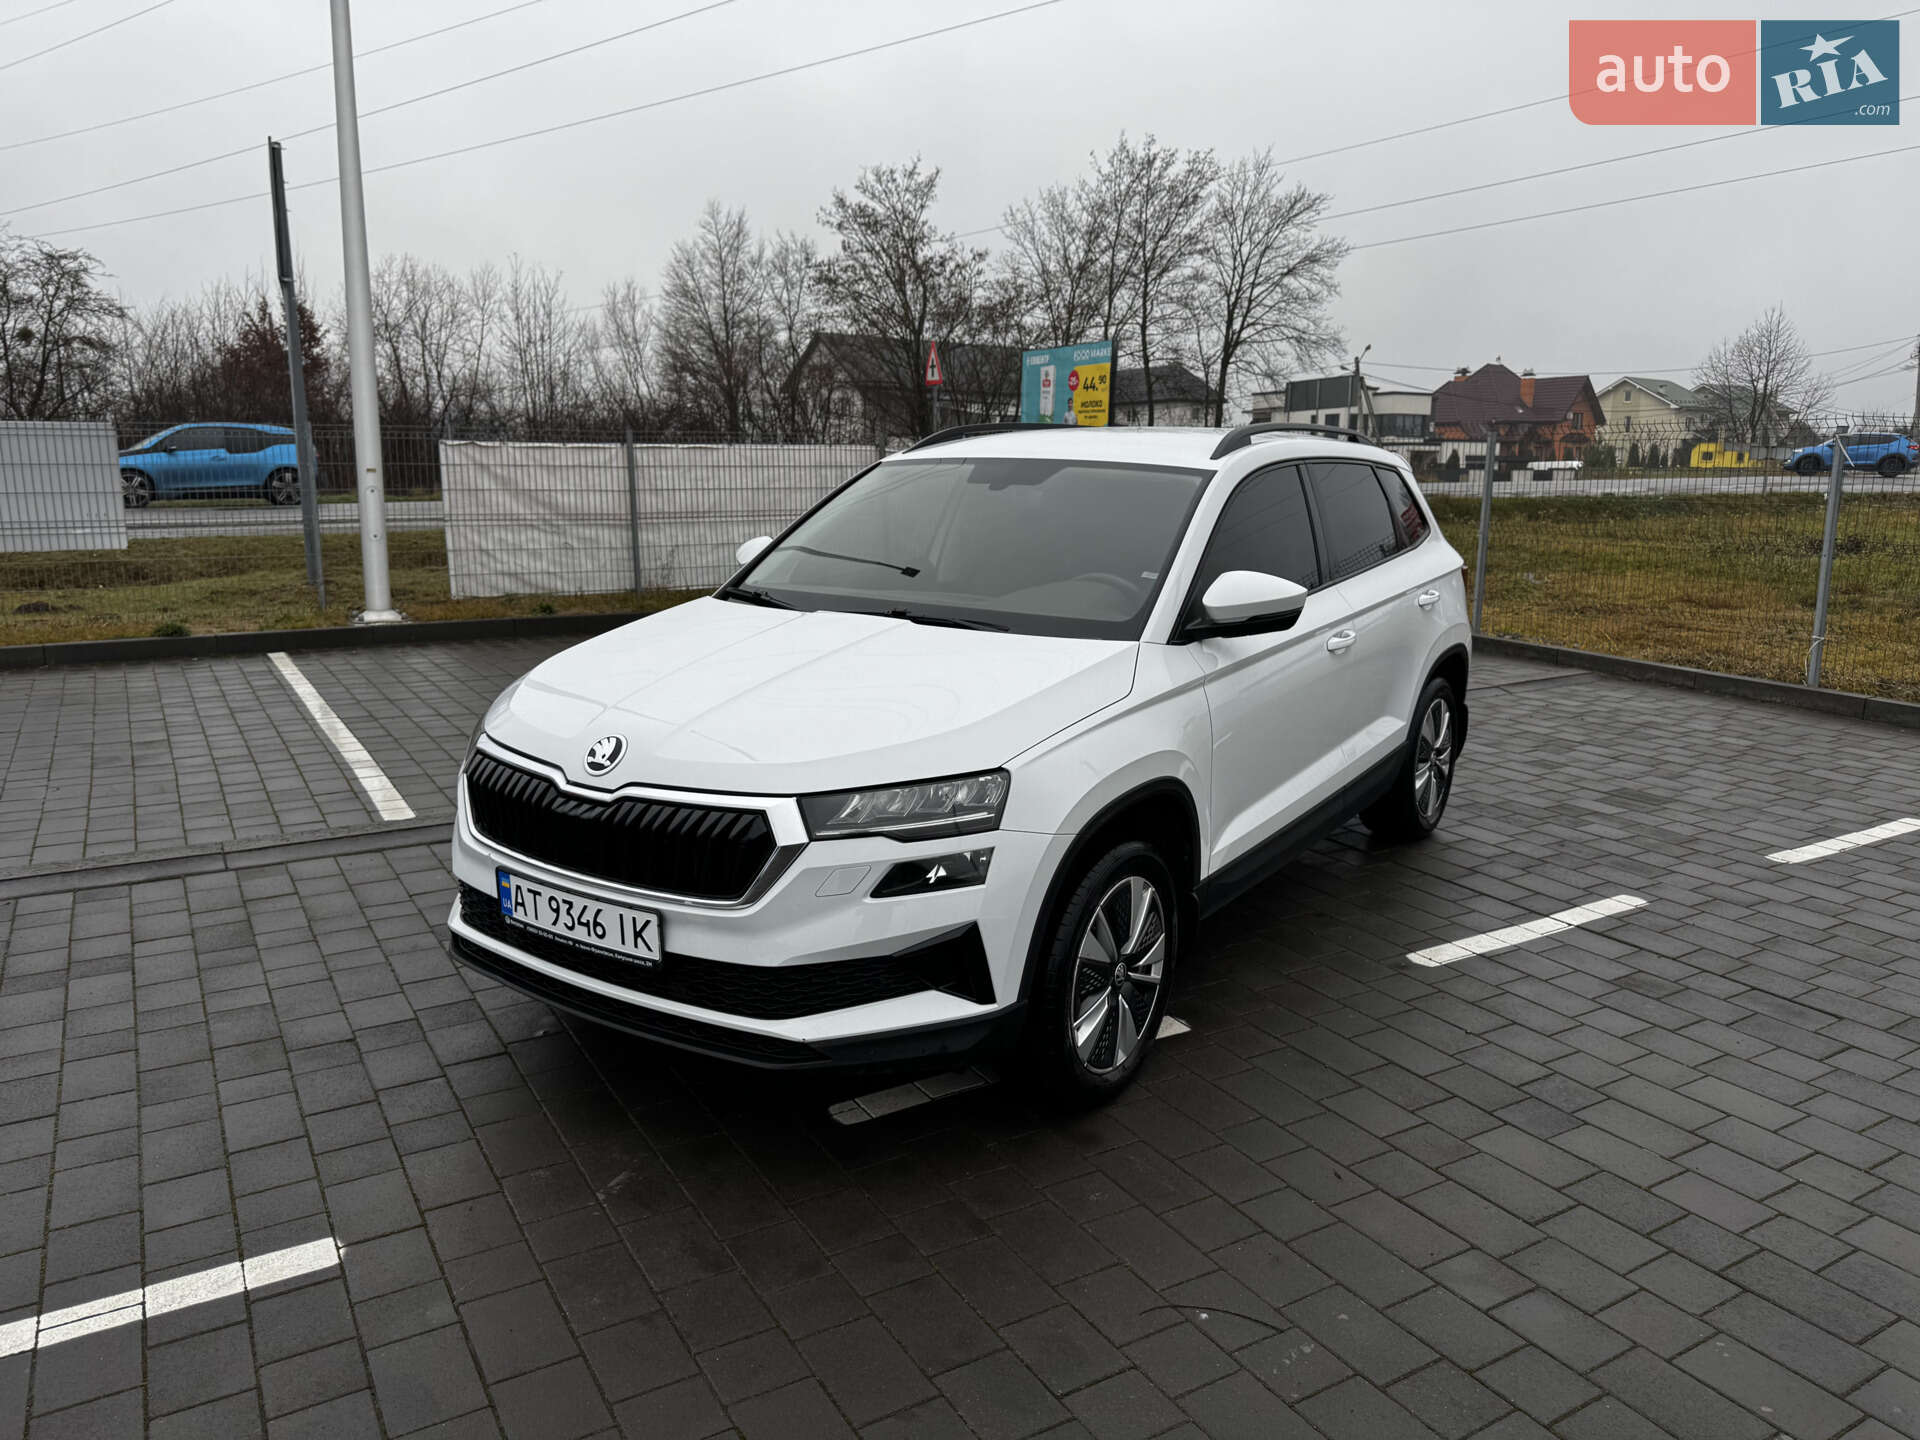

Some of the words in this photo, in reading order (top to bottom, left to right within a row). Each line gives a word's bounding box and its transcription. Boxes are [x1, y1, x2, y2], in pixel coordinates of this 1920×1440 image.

[514, 884, 542, 921] AT
[548, 895, 607, 940] 9346
[619, 913, 654, 953] IK
